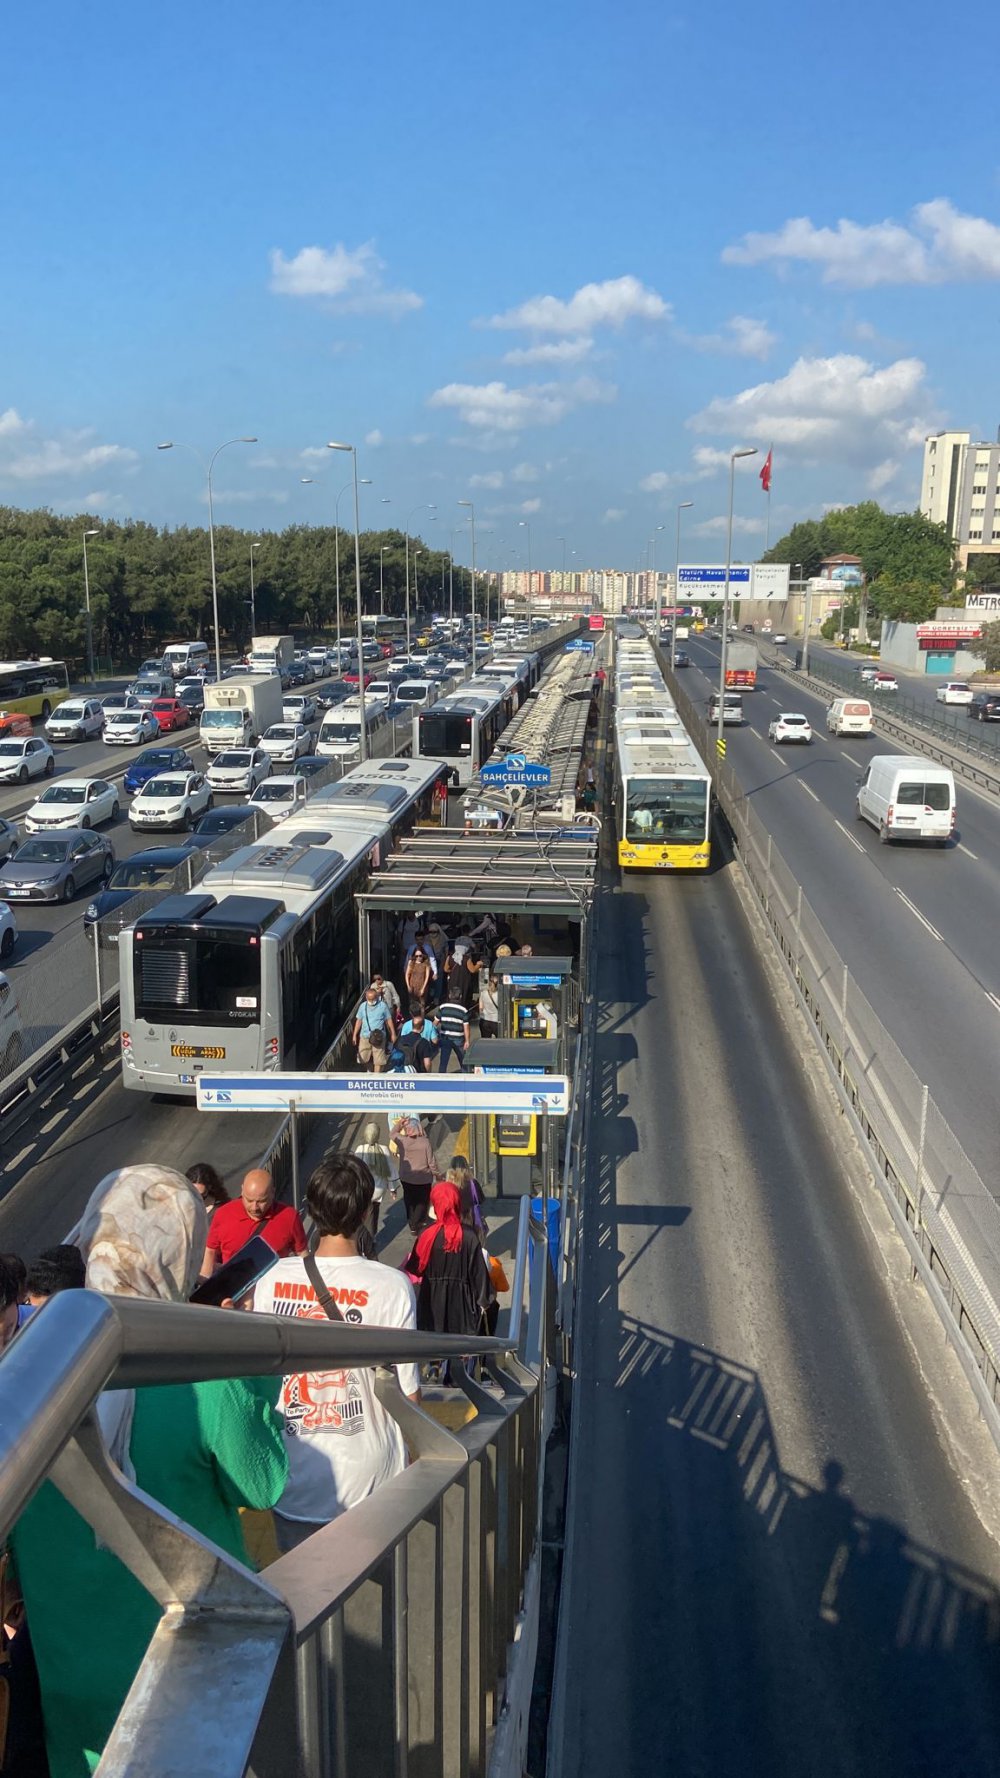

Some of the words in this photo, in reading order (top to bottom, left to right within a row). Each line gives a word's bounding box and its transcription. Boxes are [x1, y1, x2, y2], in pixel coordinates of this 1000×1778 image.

[347, 774, 422, 783] 05032
[483, 772, 548, 783] BAHÇELİEVLER
[348, 1080, 416, 1090] BAHÇELİEVLER
[274, 1281, 369, 1307] MINONS
